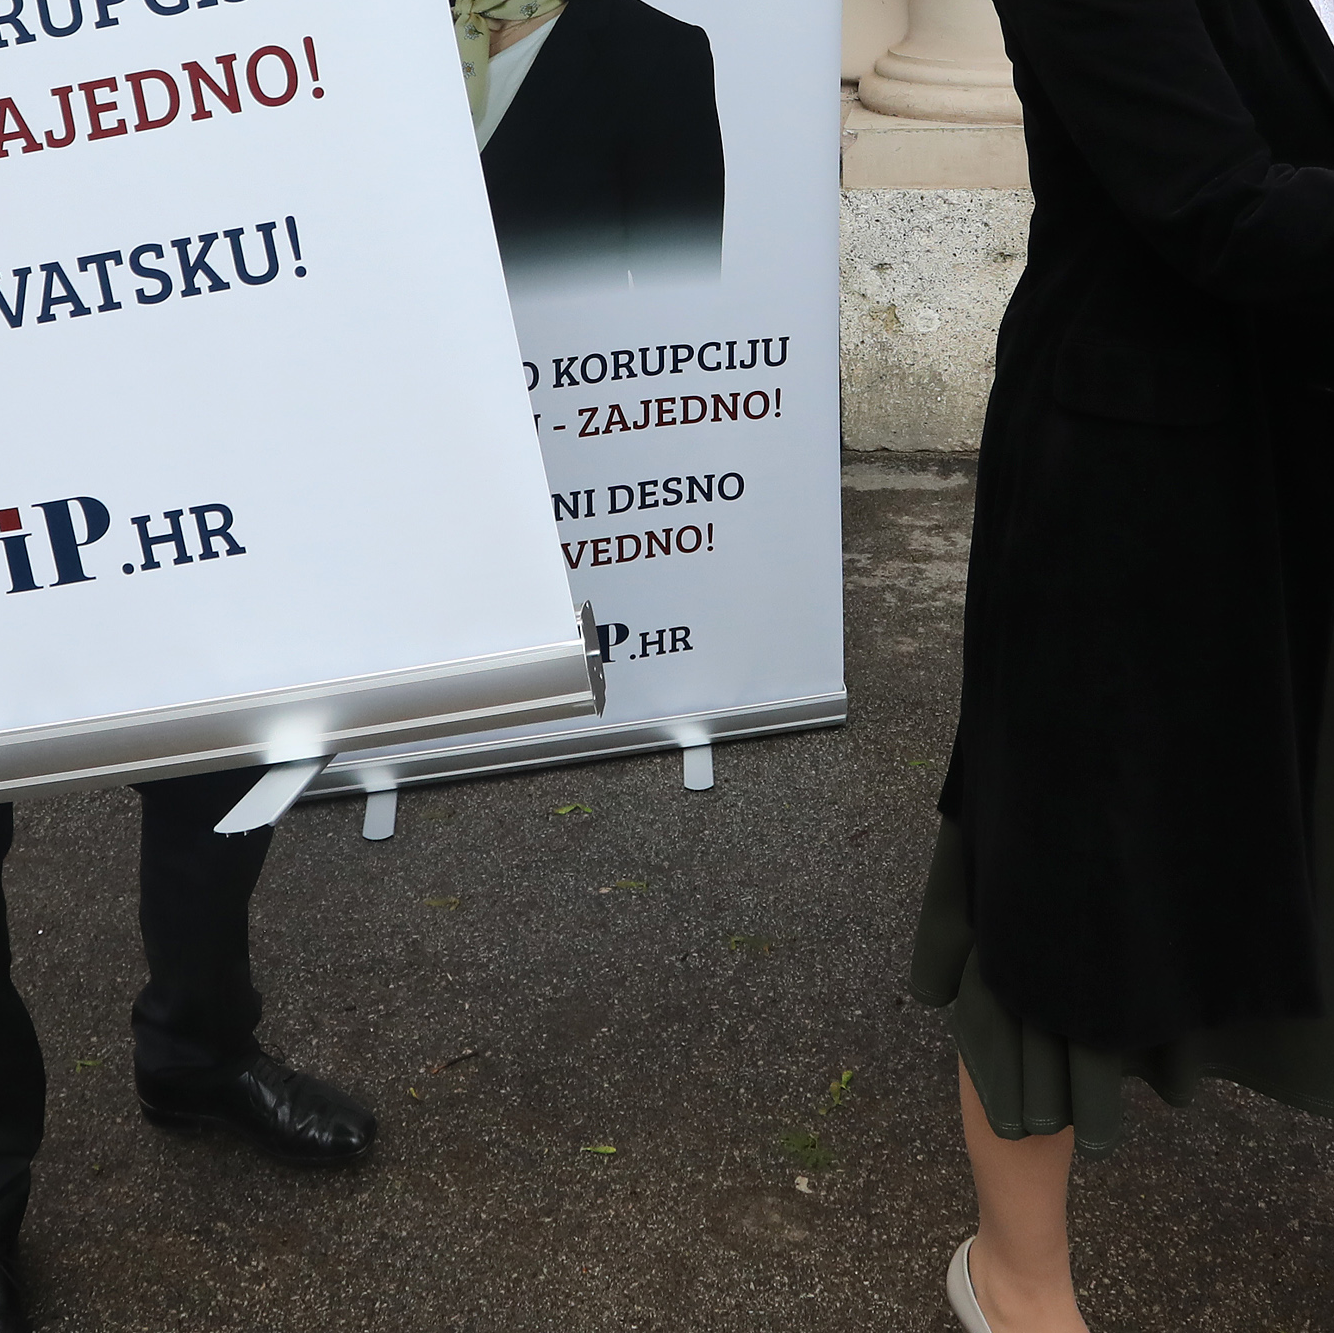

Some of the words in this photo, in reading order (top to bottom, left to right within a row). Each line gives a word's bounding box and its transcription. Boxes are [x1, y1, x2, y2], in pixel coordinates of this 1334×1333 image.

[552, 336, 790, 389] KORUPCIJU
[578, 387, 782, 438] ZAJEDNO!
[607, 472, 746, 515] DESNO
